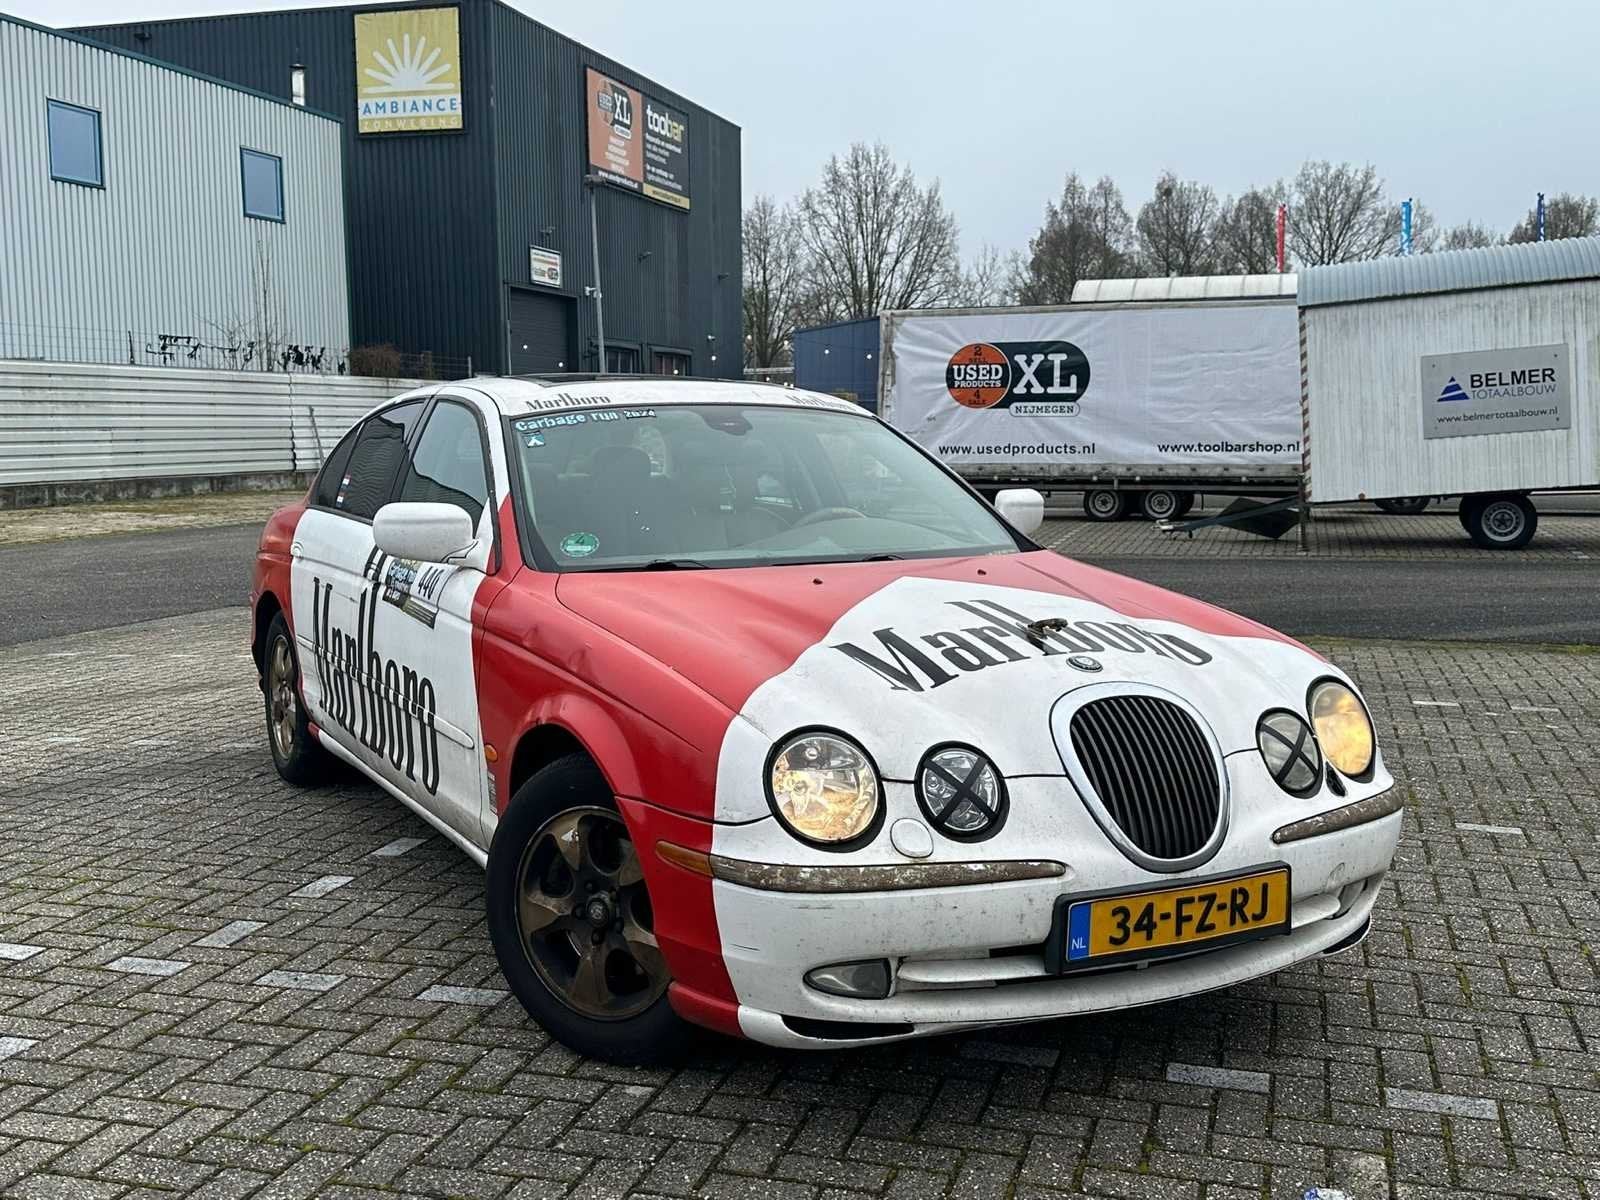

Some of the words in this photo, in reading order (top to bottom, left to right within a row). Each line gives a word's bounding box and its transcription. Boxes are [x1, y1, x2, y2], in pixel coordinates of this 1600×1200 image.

[362, 97, 457, 115] AMBIANCE
[613, 92, 631, 125] XL
[363, 117, 459, 130] ZONWERING
[974, 345, 982, 356] 2
[952, 364, 1003, 381] USED
[1012, 353, 1078, 394] XL
[1470, 367, 1556, 388] BELMER
[954, 380, 1001, 388] PRODUCTS
[1472, 384, 1557, 400] TOTAALBOUW
[524, 392, 611, 411] Marlboro
[973, 389, 981, 399] 4
[623, 408, 656, 420] 2024
[1015, 404, 1074, 414] NIJMEGEN
[1437, 406, 1558, 424] www.belmertotaalbouw.nl
[938, 443, 1096, 456] www.usedproducts.nl
[1157, 441, 1300, 454] www.toolbarshop.nl
[829, 599, 1213, 692] Marlboro
[1109, 882, 1269, 945] 34-FZ-RJ
[1071, 938, 1087, 949] NL
